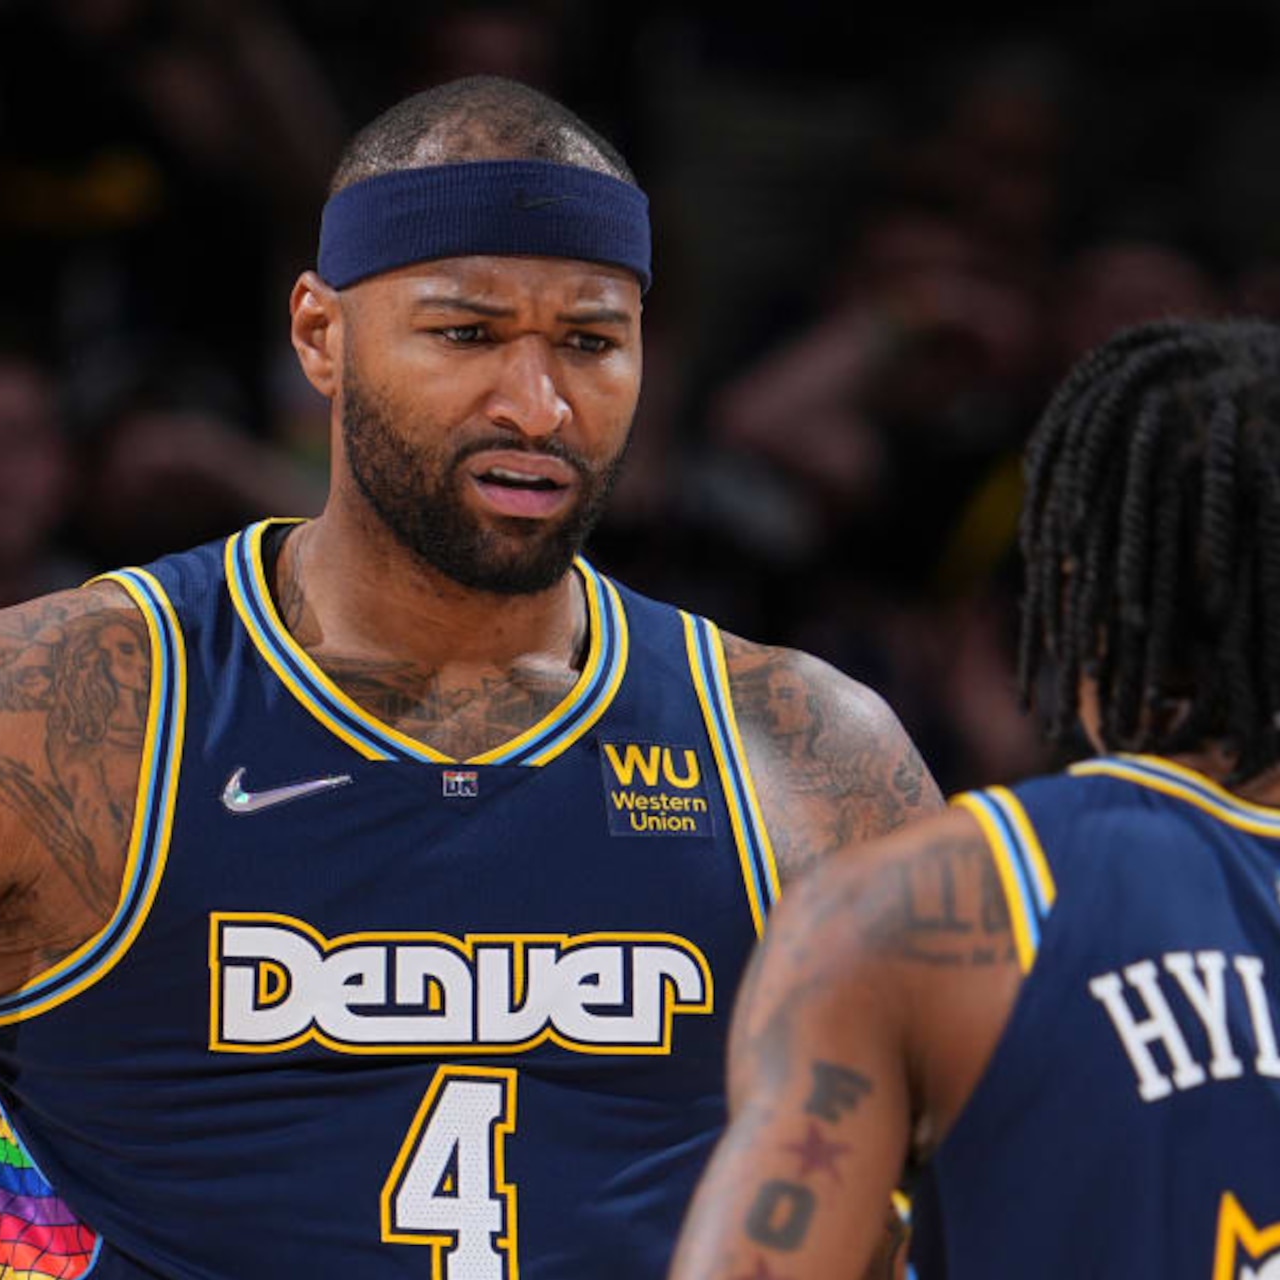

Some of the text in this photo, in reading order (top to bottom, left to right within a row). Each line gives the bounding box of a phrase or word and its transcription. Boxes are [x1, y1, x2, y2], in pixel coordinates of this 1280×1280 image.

[603, 743, 700, 789] WU
[611, 790, 708, 813] Western
[630, 811, 697, 832] Union
[209, 912, 714, 1055] Denver
